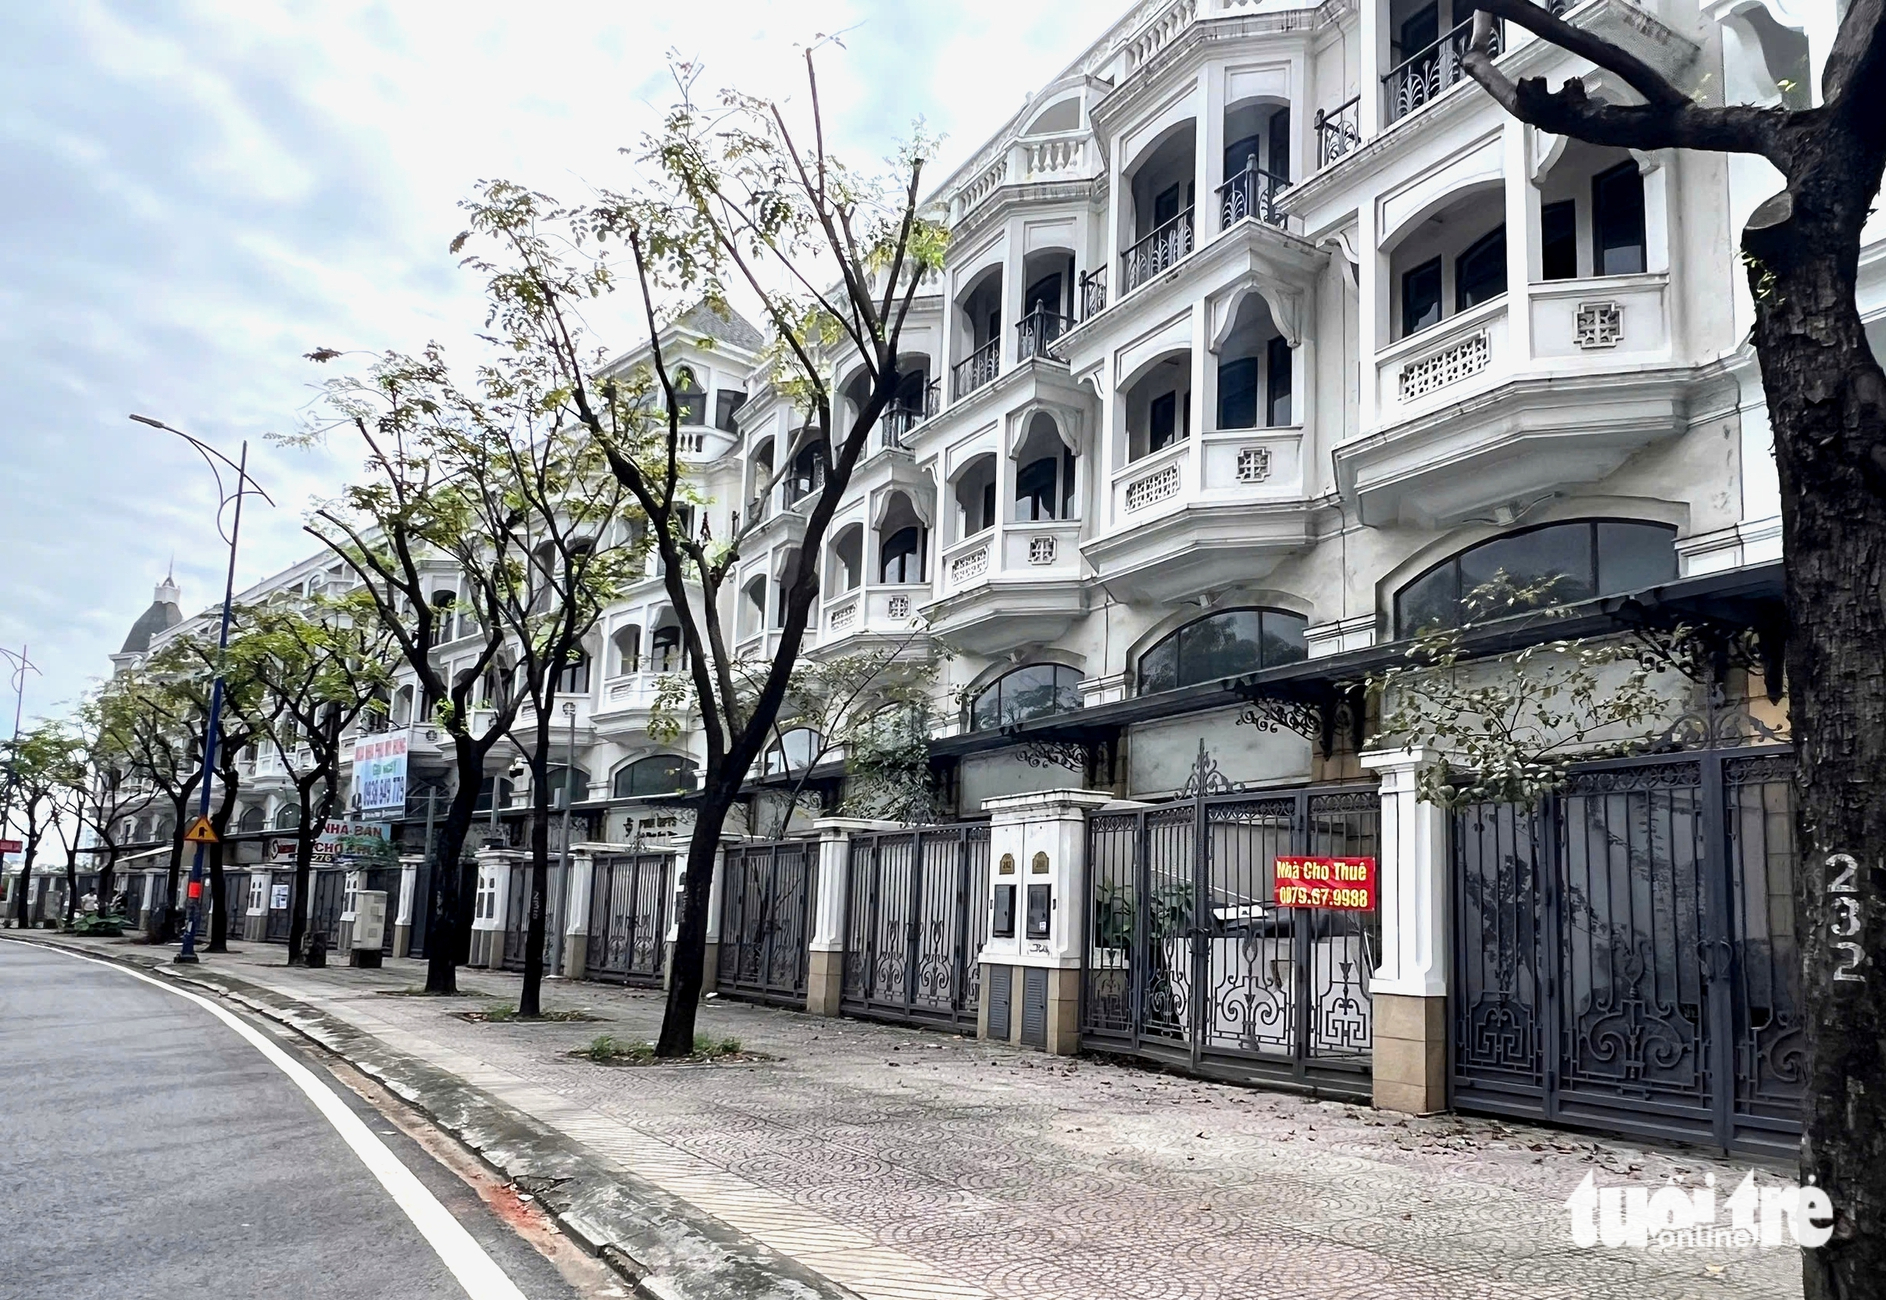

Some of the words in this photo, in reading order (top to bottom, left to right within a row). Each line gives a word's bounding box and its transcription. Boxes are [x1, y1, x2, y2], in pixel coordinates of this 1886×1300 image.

[1276, 861, 1299, 879] Nhà
[1303, 861, 1329, 880] Cho
[1333, 861, 1367, 881] Thuê
[1825, 853, 1867, 982] 232
